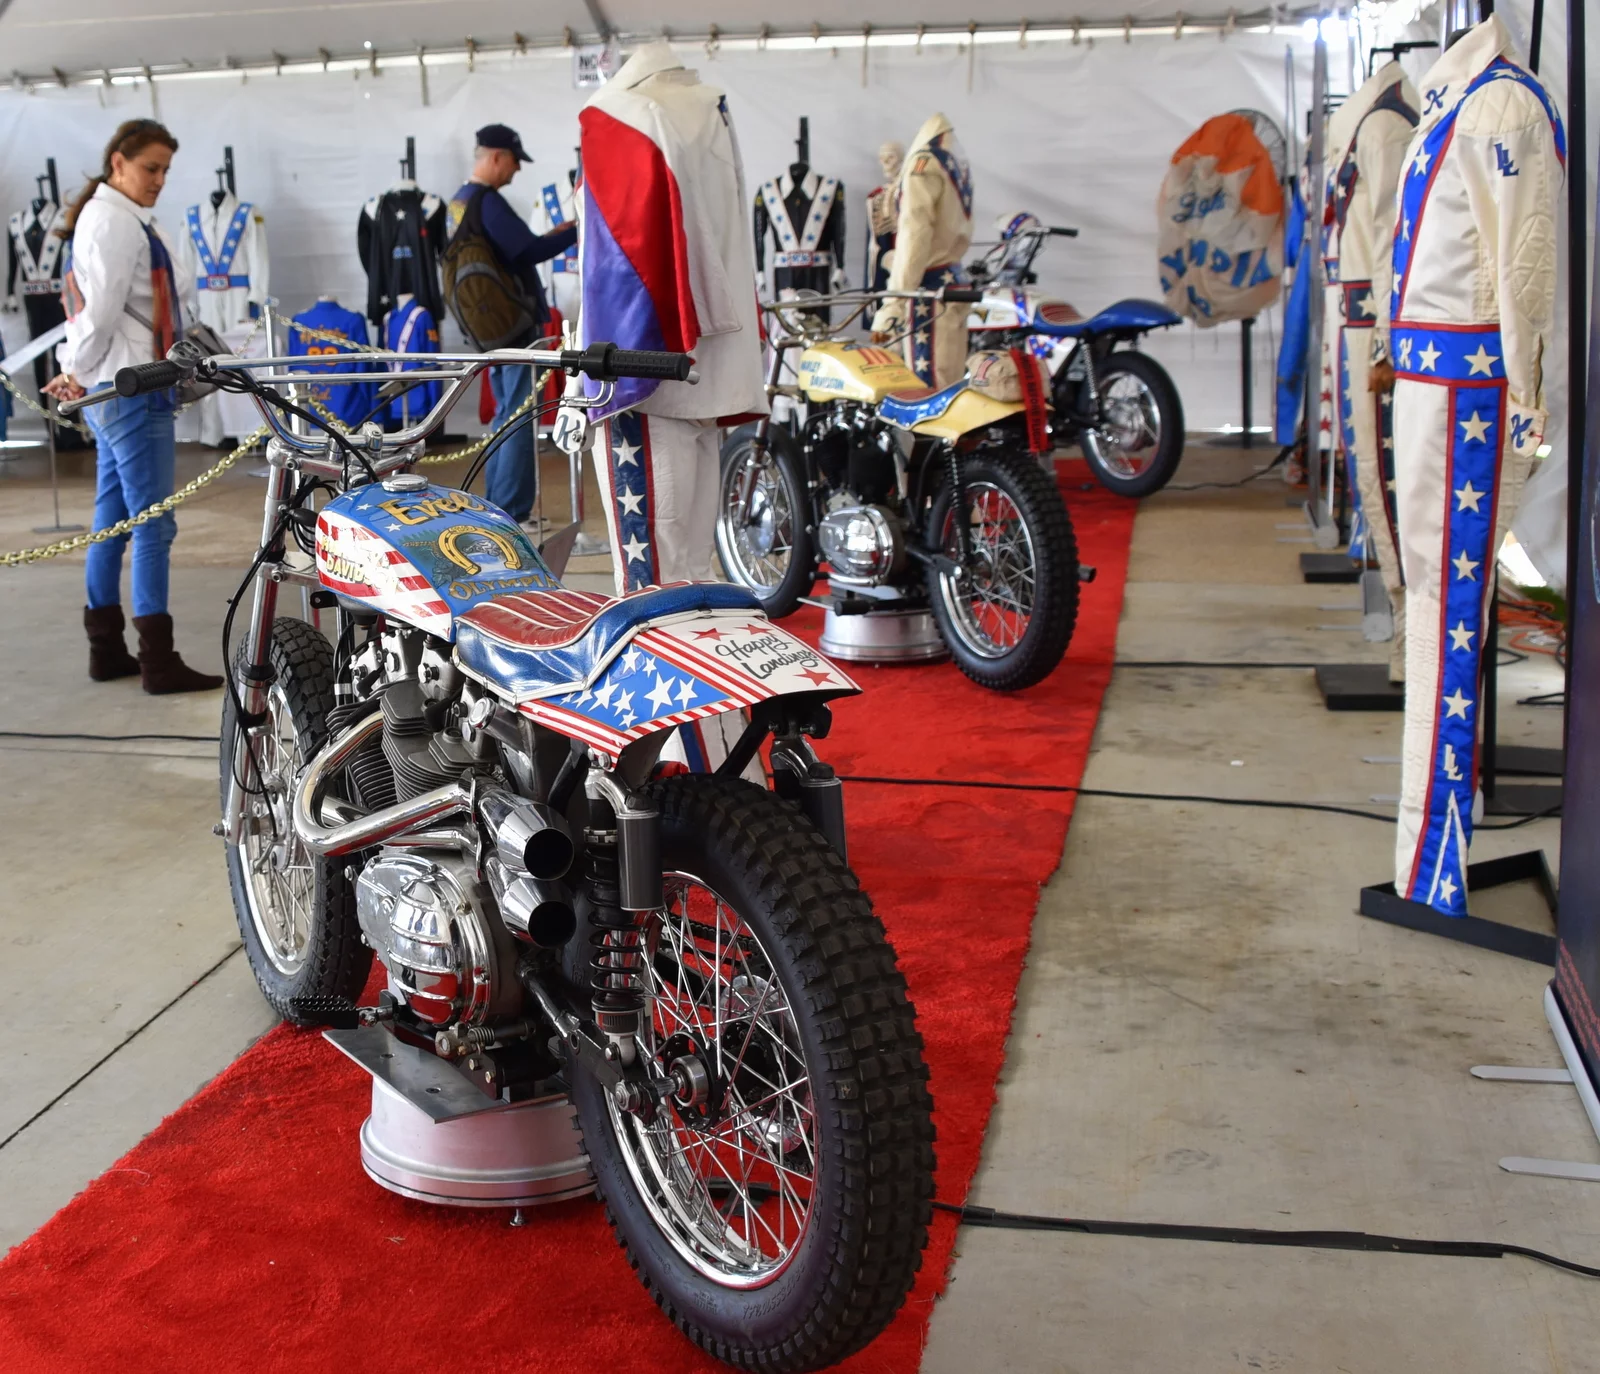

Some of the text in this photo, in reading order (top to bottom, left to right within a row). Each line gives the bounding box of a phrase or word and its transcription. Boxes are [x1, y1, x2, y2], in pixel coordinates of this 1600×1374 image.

[377, 491, 487, 526] Evel
[449, 574, 563, 601] OLYMPIA
[715, 633, 794, 662] Happy
[741, 649, 820, 680] Landings
